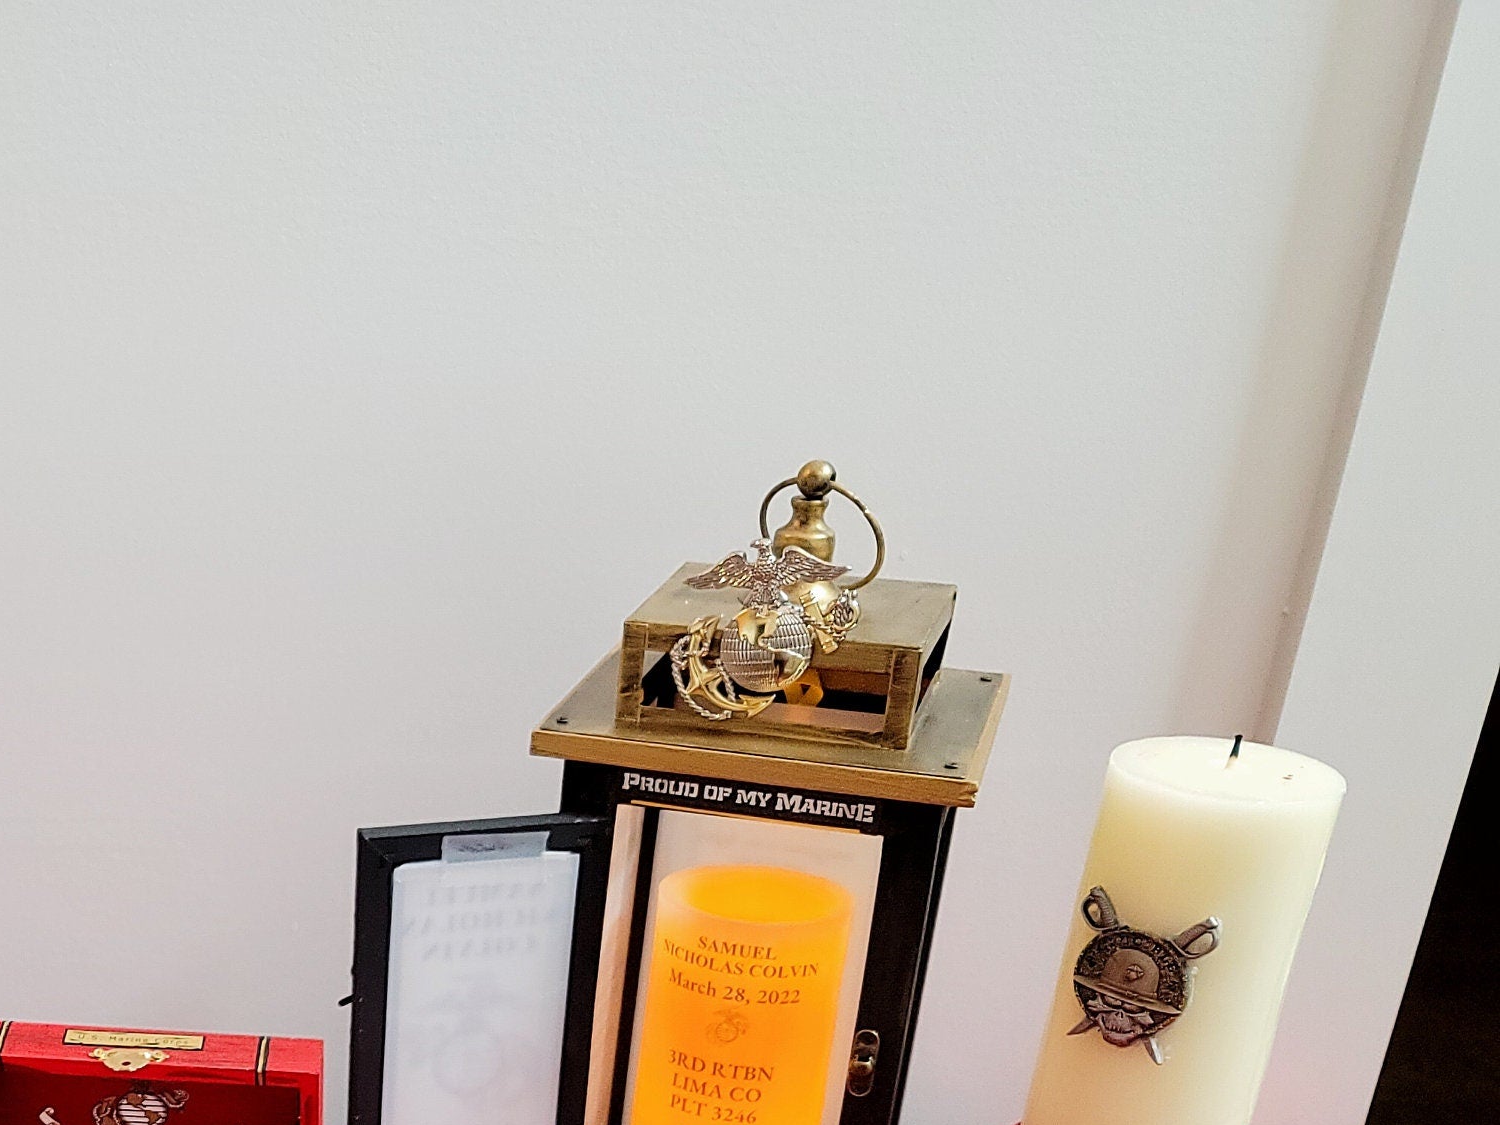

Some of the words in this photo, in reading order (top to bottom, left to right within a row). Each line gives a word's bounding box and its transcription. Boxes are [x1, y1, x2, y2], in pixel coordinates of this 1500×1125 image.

[622, 772, 699, 798] PROUD
[703, 785, 732, 801] OF
[736, 789, 772, 808] MY
[775, 792, 876, 823] MARINE
[664, 938, 744, 976] NICHOLAS
[749, 962, 819, 979] COLVIN
[698, 935, 777, 961] SAMUEL
[669, 967, 716, 998] March
[722, 986, 750, 1006] 28,
[756, 989, 801, 1005] 2022
[668, 1050, 706, 1073] 3RD
[711, 1062, 775, 1082] RTBN
[672, 1072, 722, 1099] LIMA
[729, 1086, 762, 1103] CO
[670, 1094, 707, 1117] PLT
[711, 1105, 757, 1125] 3246
